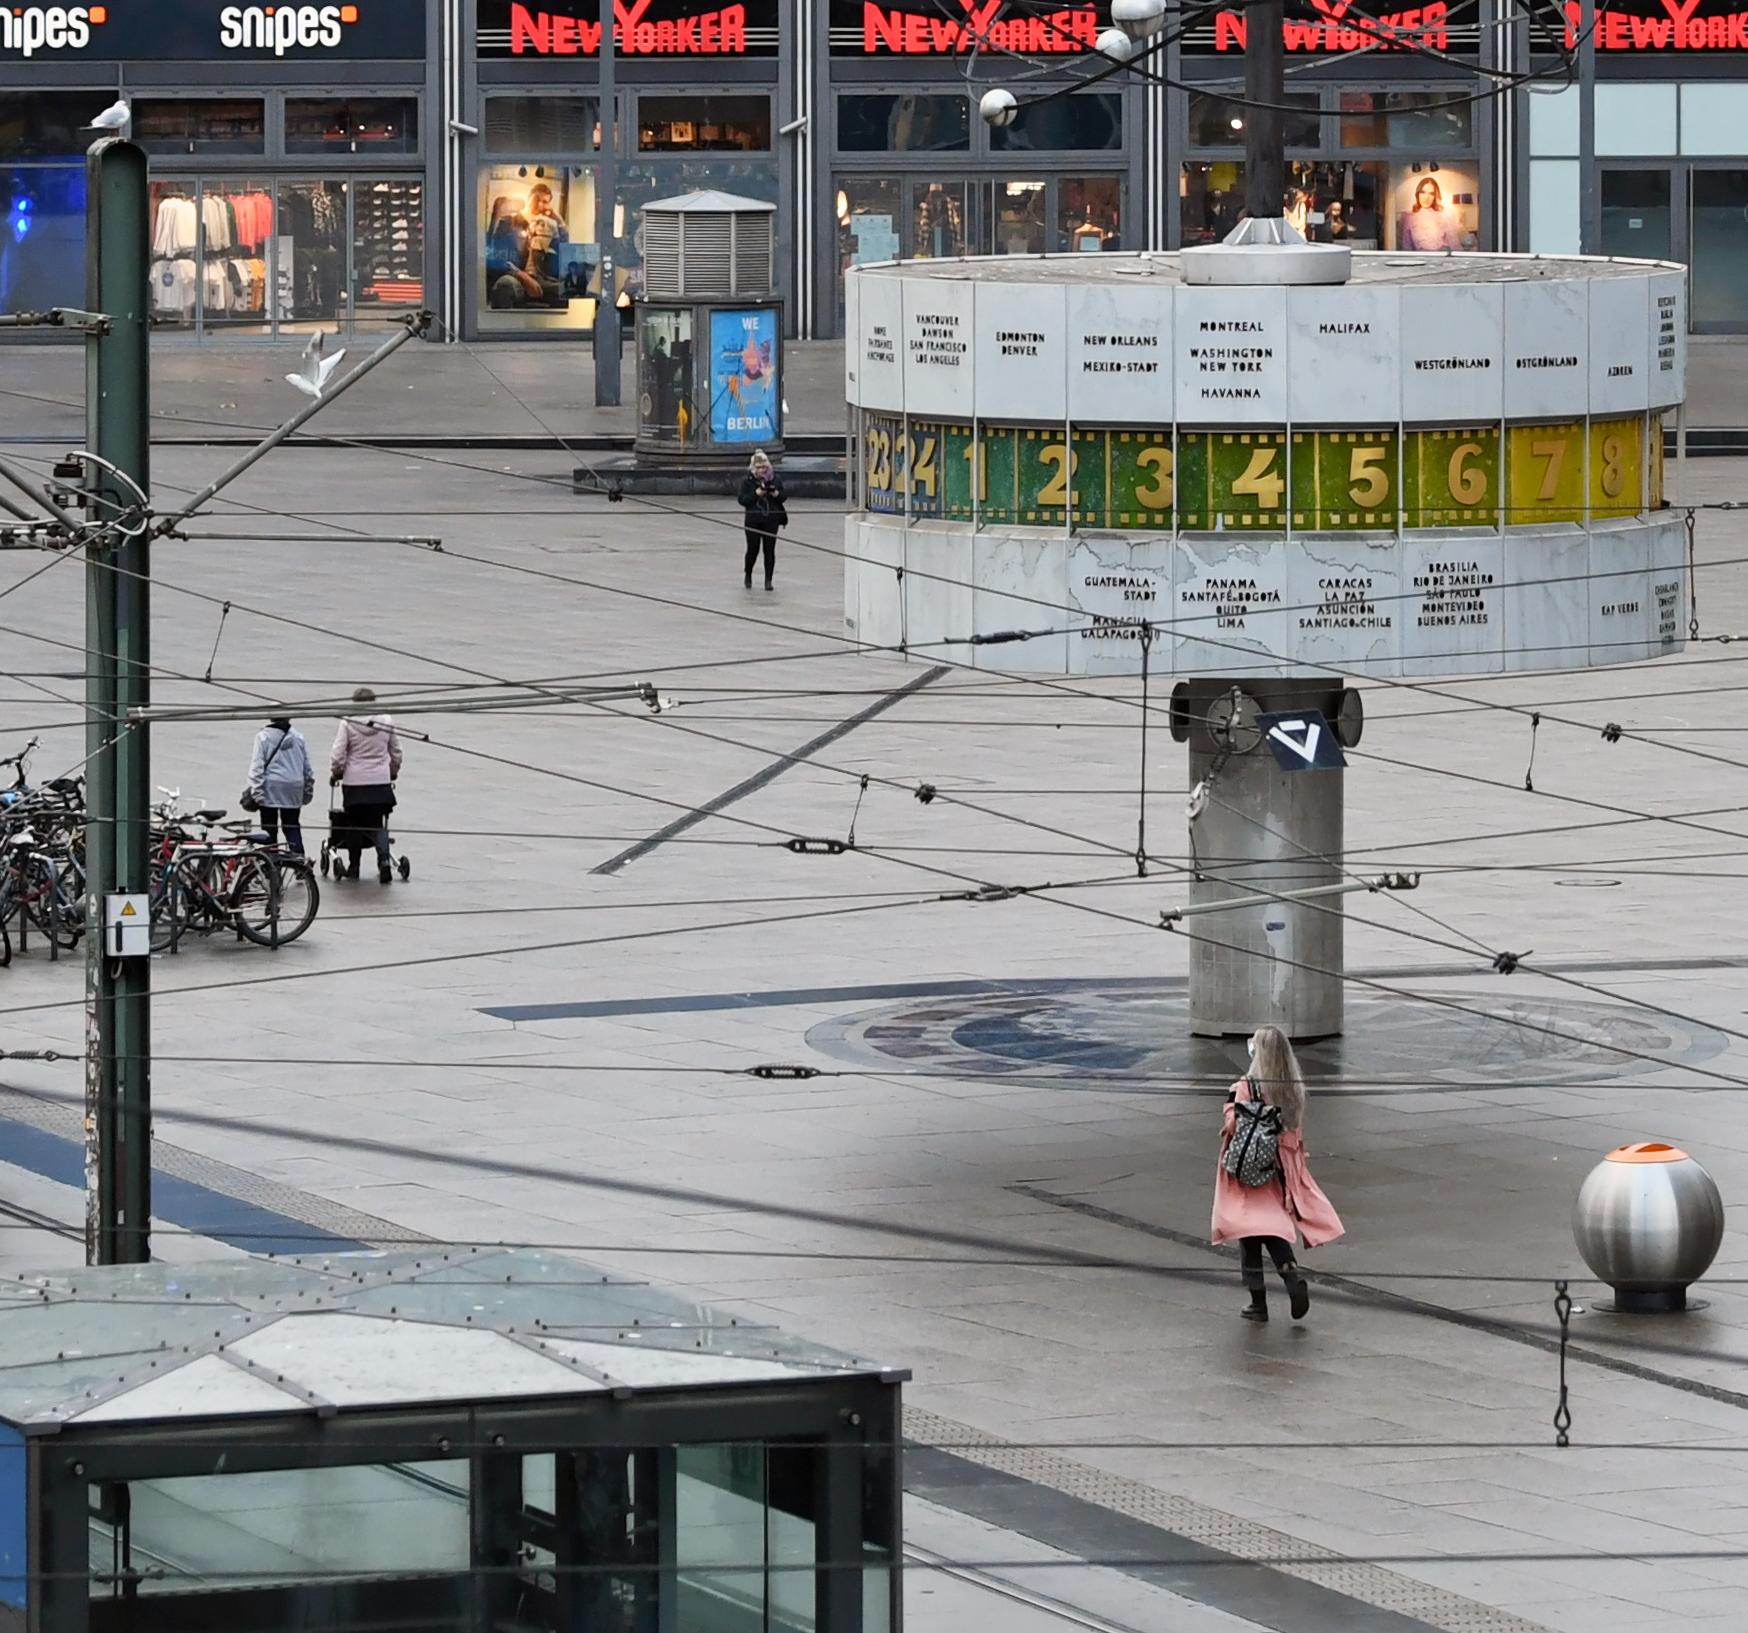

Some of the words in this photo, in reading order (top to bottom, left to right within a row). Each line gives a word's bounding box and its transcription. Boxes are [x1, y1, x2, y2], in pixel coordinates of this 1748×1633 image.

[220, 6, 341, 56] snipes
[741, 317, 759, 330] WE
[916, 314, 959, 326] VANCOUVER
[922, 328, 953, 338] DAWSON
[1200, 322, 1264, 332] MONTREAL
[1319, 323, 1370, 334] HALIFAX
[996, 331, 1045, 343] EDMONTON
[1084, 335, 1107, 346] NEW
[1110, 335, 1158, 346] ORLEANS
[910, 339, 924, 351] SAN
[926, 340, 967, 353] FRANCISCO
[1002, 345, 1038, 356] DENVER
[915, 353, 928, 365] LOS
[929, 354, 960, 366] ANGELES
[1190, 348, 1273, 358] WASHINGTON
[1083, 362, 1158, 373] MEXIKO-STADT
[1200, 362, 1226, 372] NEW
[1232, 362, 1263, 372] YORK
[1414, 356, 1490, 370] WESTGRÖNLAND
[1516, 355, 1578, 369] OSTGRÖNLAND
[1201, 388, 1261, 398] HAVANNA
[727, 417, 770, 430] BERLIN
[866, 428, 891, 490] 23
[895, 433, 936, 497] 24
[963, 442, 987, 501] 1
[1531, 439, 1567, 500] 7
[1601, 435, 1626, 497] 8
[1037, 444, 1079, 505] 2
[1135, 447, 1174, 509] 3
[1231, 448, 1284, 509] 4
[1349, 446, 1389, 508] 5
[1448, 443, 1487, 506] 6
[1429, 562, 1479, 573] BRASILIA
[1084, 576, 1156, 587] GUATEMALA-
[1206, 578, 1257, 589] PANAMA
[1318, 578, 1373, 589] CARACAS
[1414, 576, 1429, 587] RIO
[1433, 575, 1445, 586] DE
[1448, 574, 1493, 585] JANEIRO
[1124, 591, 1156, 602] STADT
[1325, 591, 1340, 602] LA
[1344, 591, 1365, 602] PAZ
[1216, 604, 1248, 615] QUITO
[1317, 601, 1375, 615] ASUNCIÓN
[1422, 601, 1485, 614] MONTEVIDEO
[1217, 617, 1245, 629] LIMA
[1417, 615, 1456, 627] BUENOS
[1459, 613, 1488, 625] AIRES
